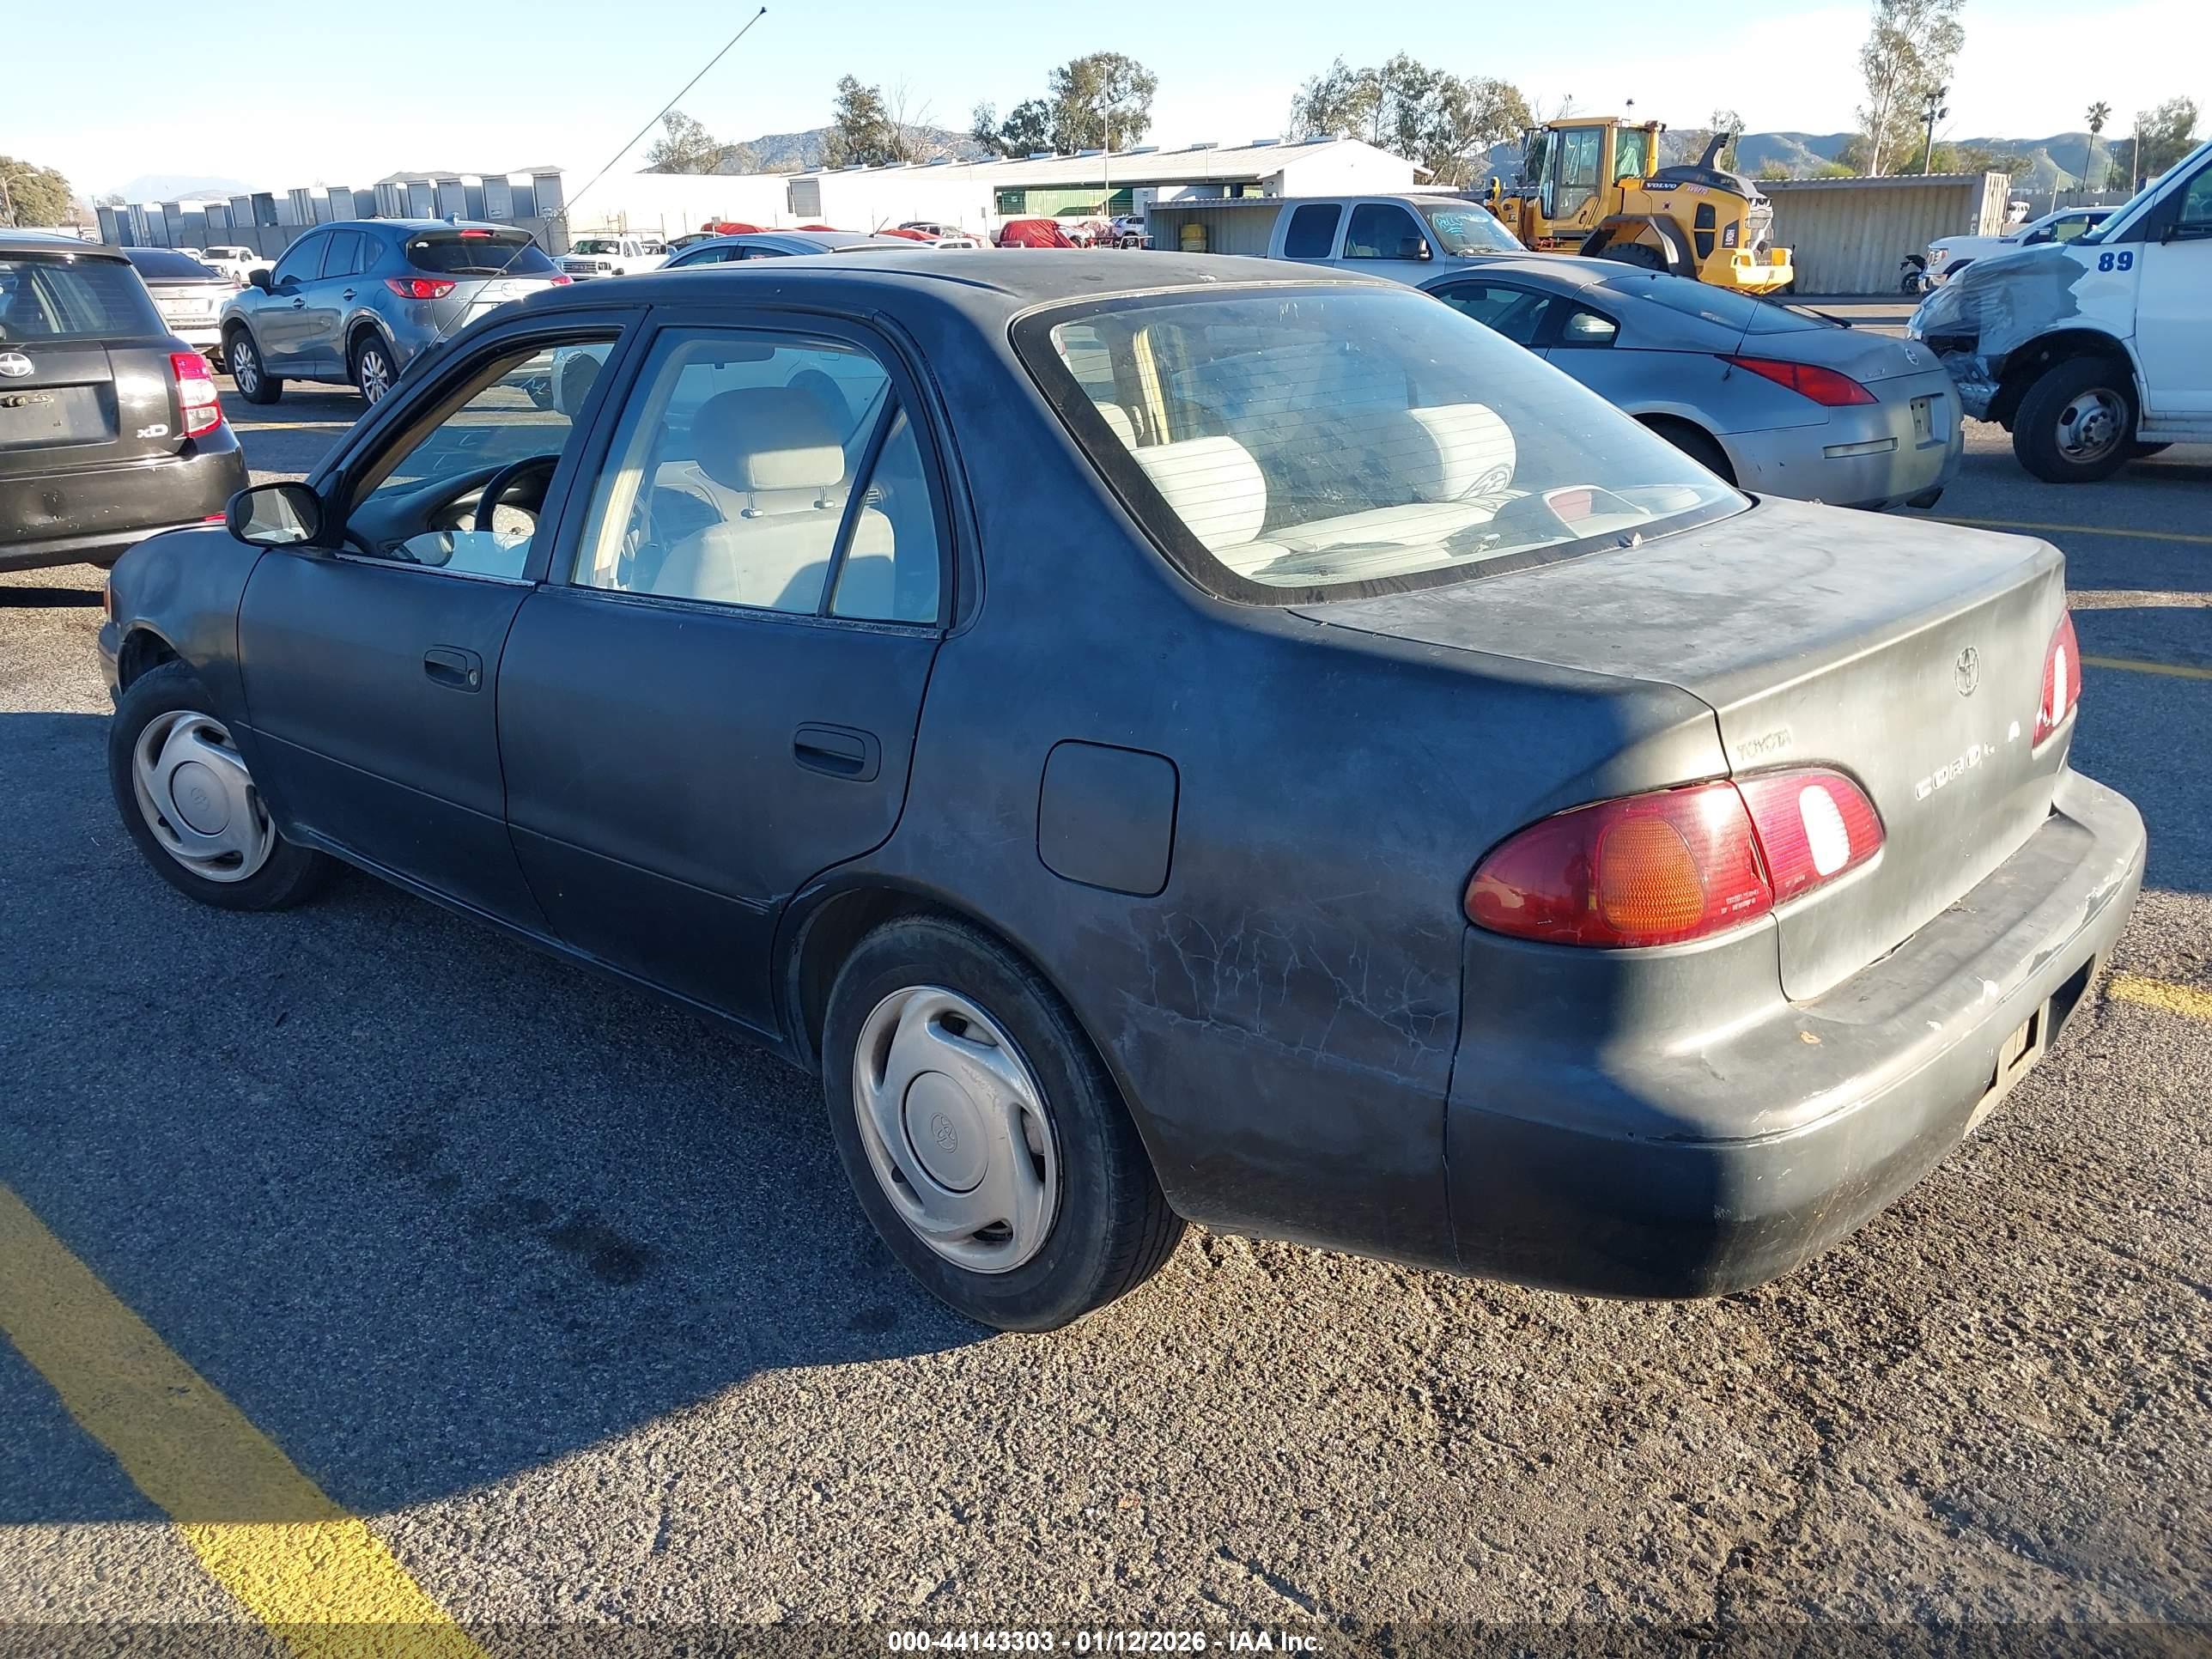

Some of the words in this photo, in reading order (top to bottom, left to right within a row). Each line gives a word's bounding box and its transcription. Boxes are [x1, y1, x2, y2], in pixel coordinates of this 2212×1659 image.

[1724, 229, 1735, 246] L90H
[2098, 251, 2134, 272] 89
[137, 423, 169, 438] xD
[1736, 728, 1792, 762] TOYOTA
